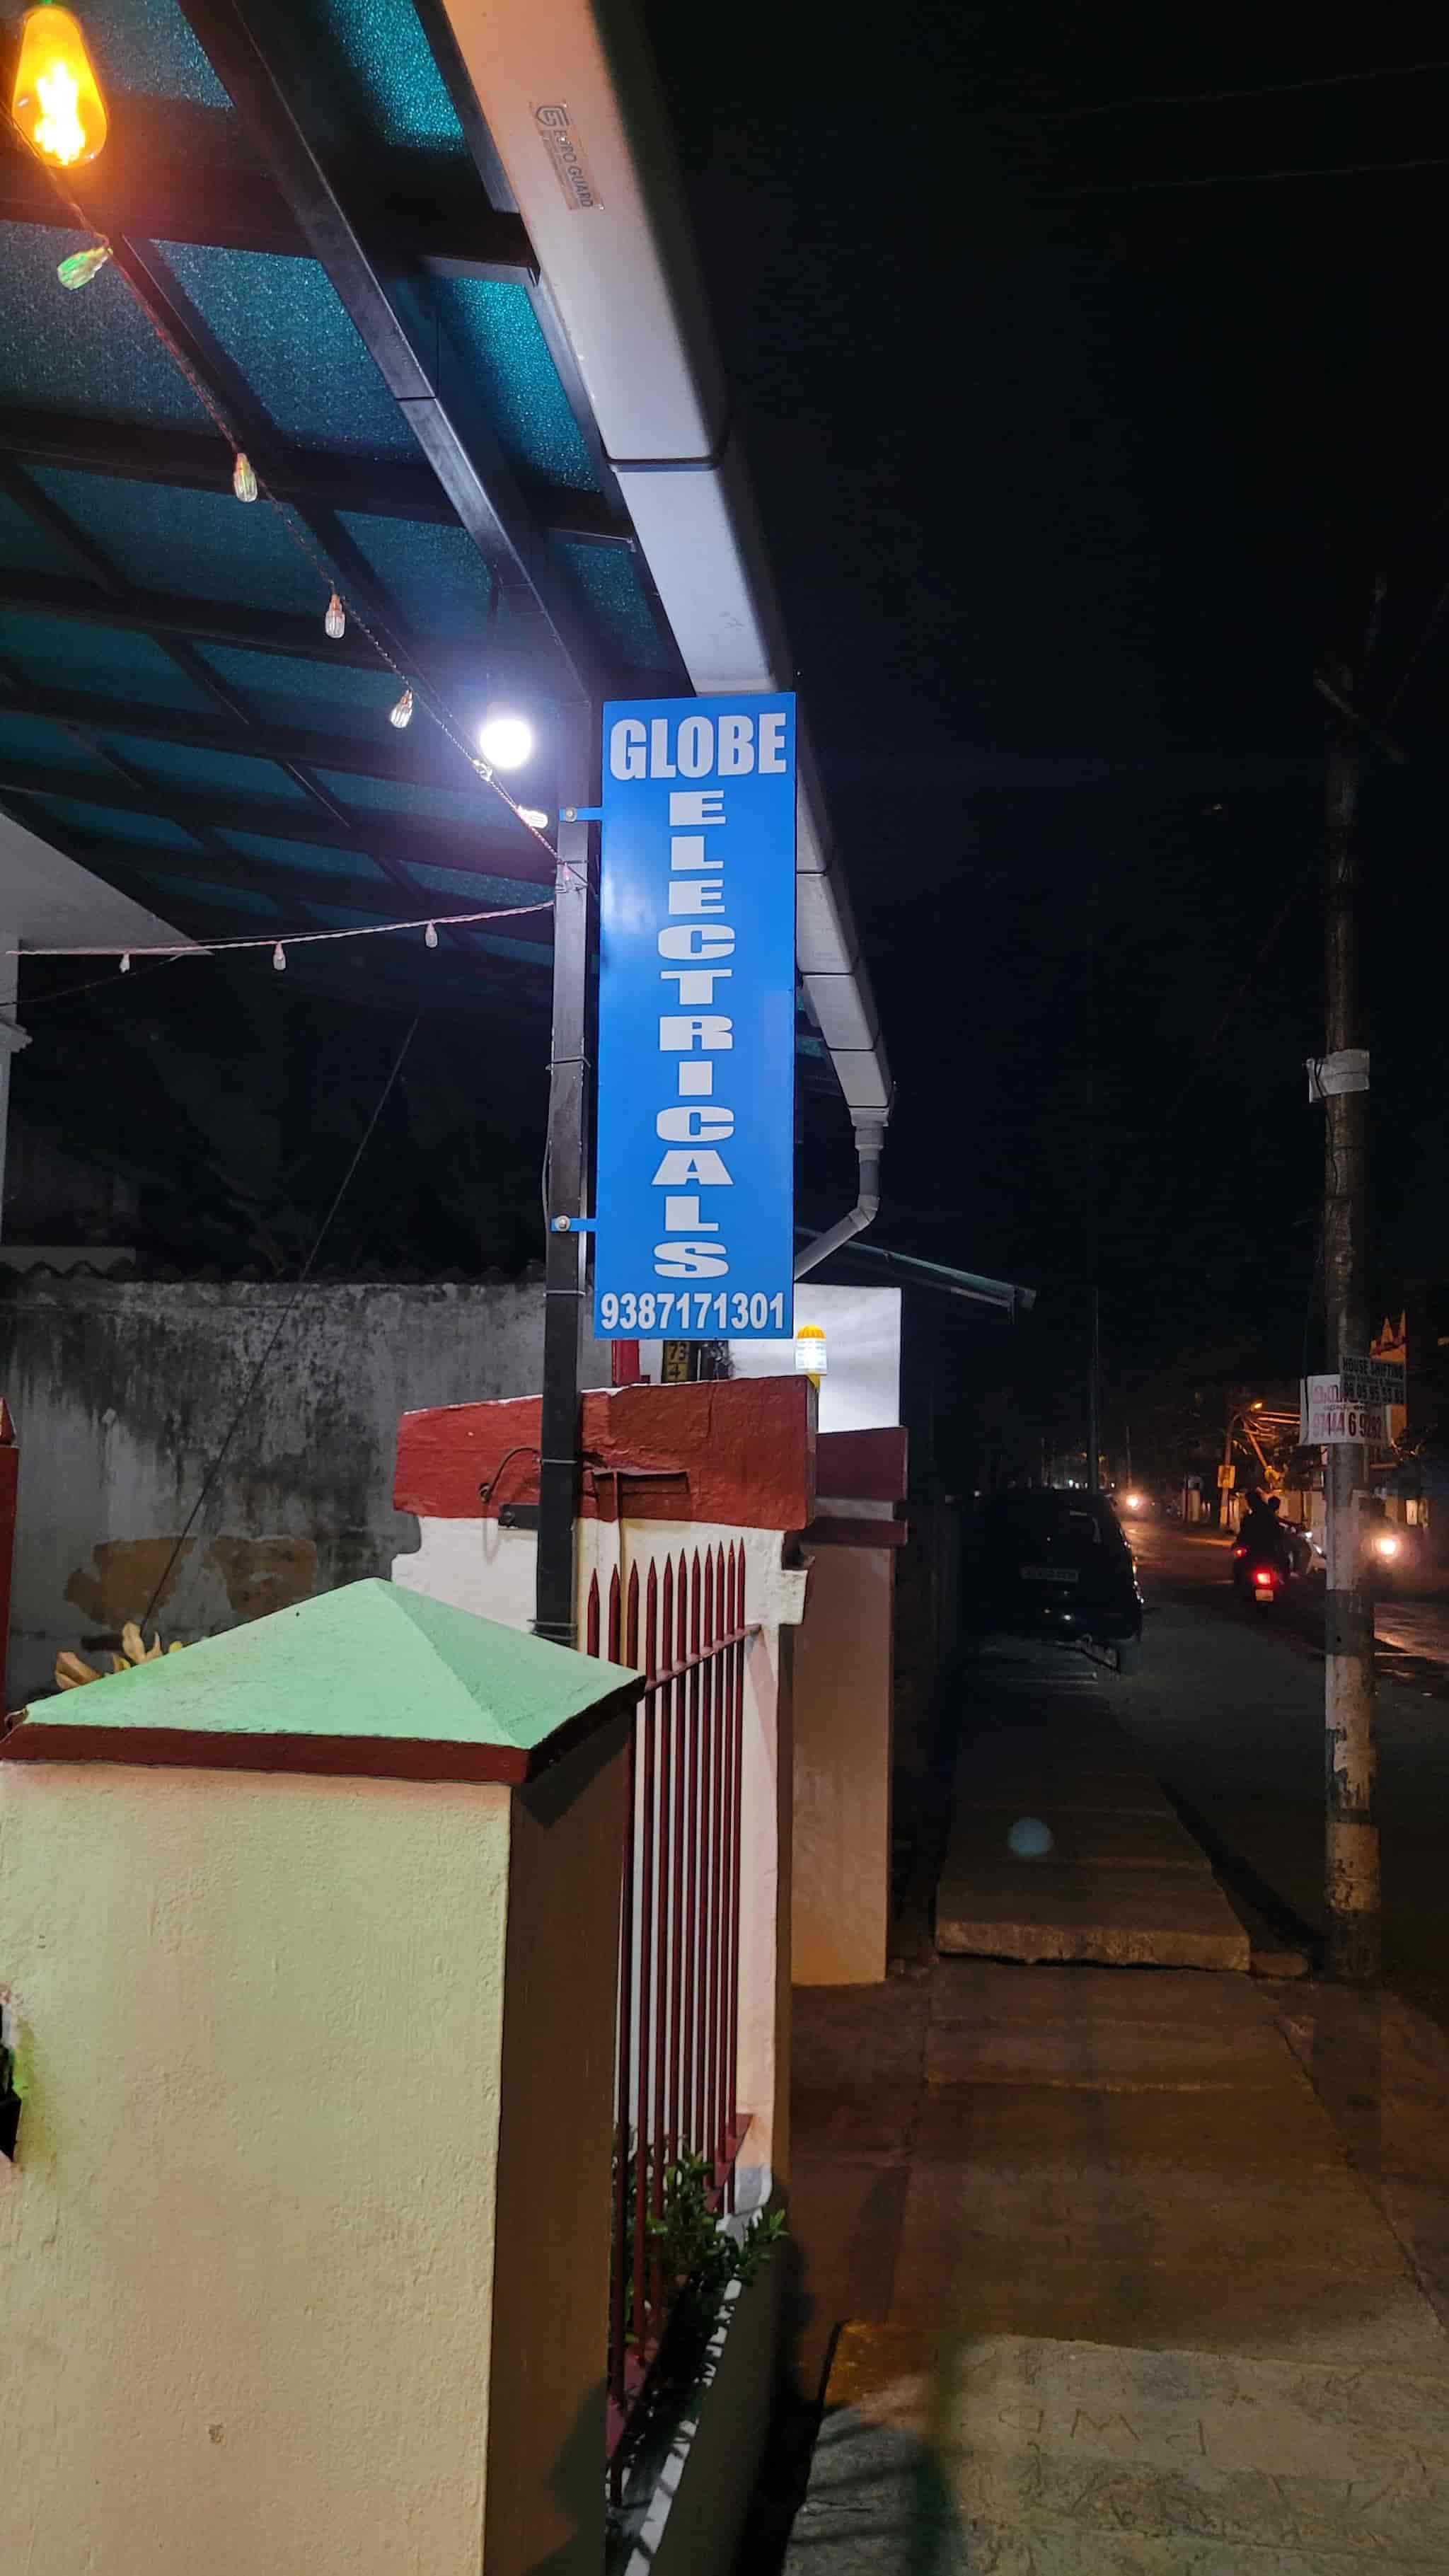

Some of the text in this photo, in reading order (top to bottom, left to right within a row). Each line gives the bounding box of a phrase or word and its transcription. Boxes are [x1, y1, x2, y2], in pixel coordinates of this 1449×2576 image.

[567, 166, 594, 208] GUARD
[610, 712, 787, 781] GLOBE
[650, 790, 736, 1279] ELECTRICALS
[600, 1291, 785, 1330] 9387171301
